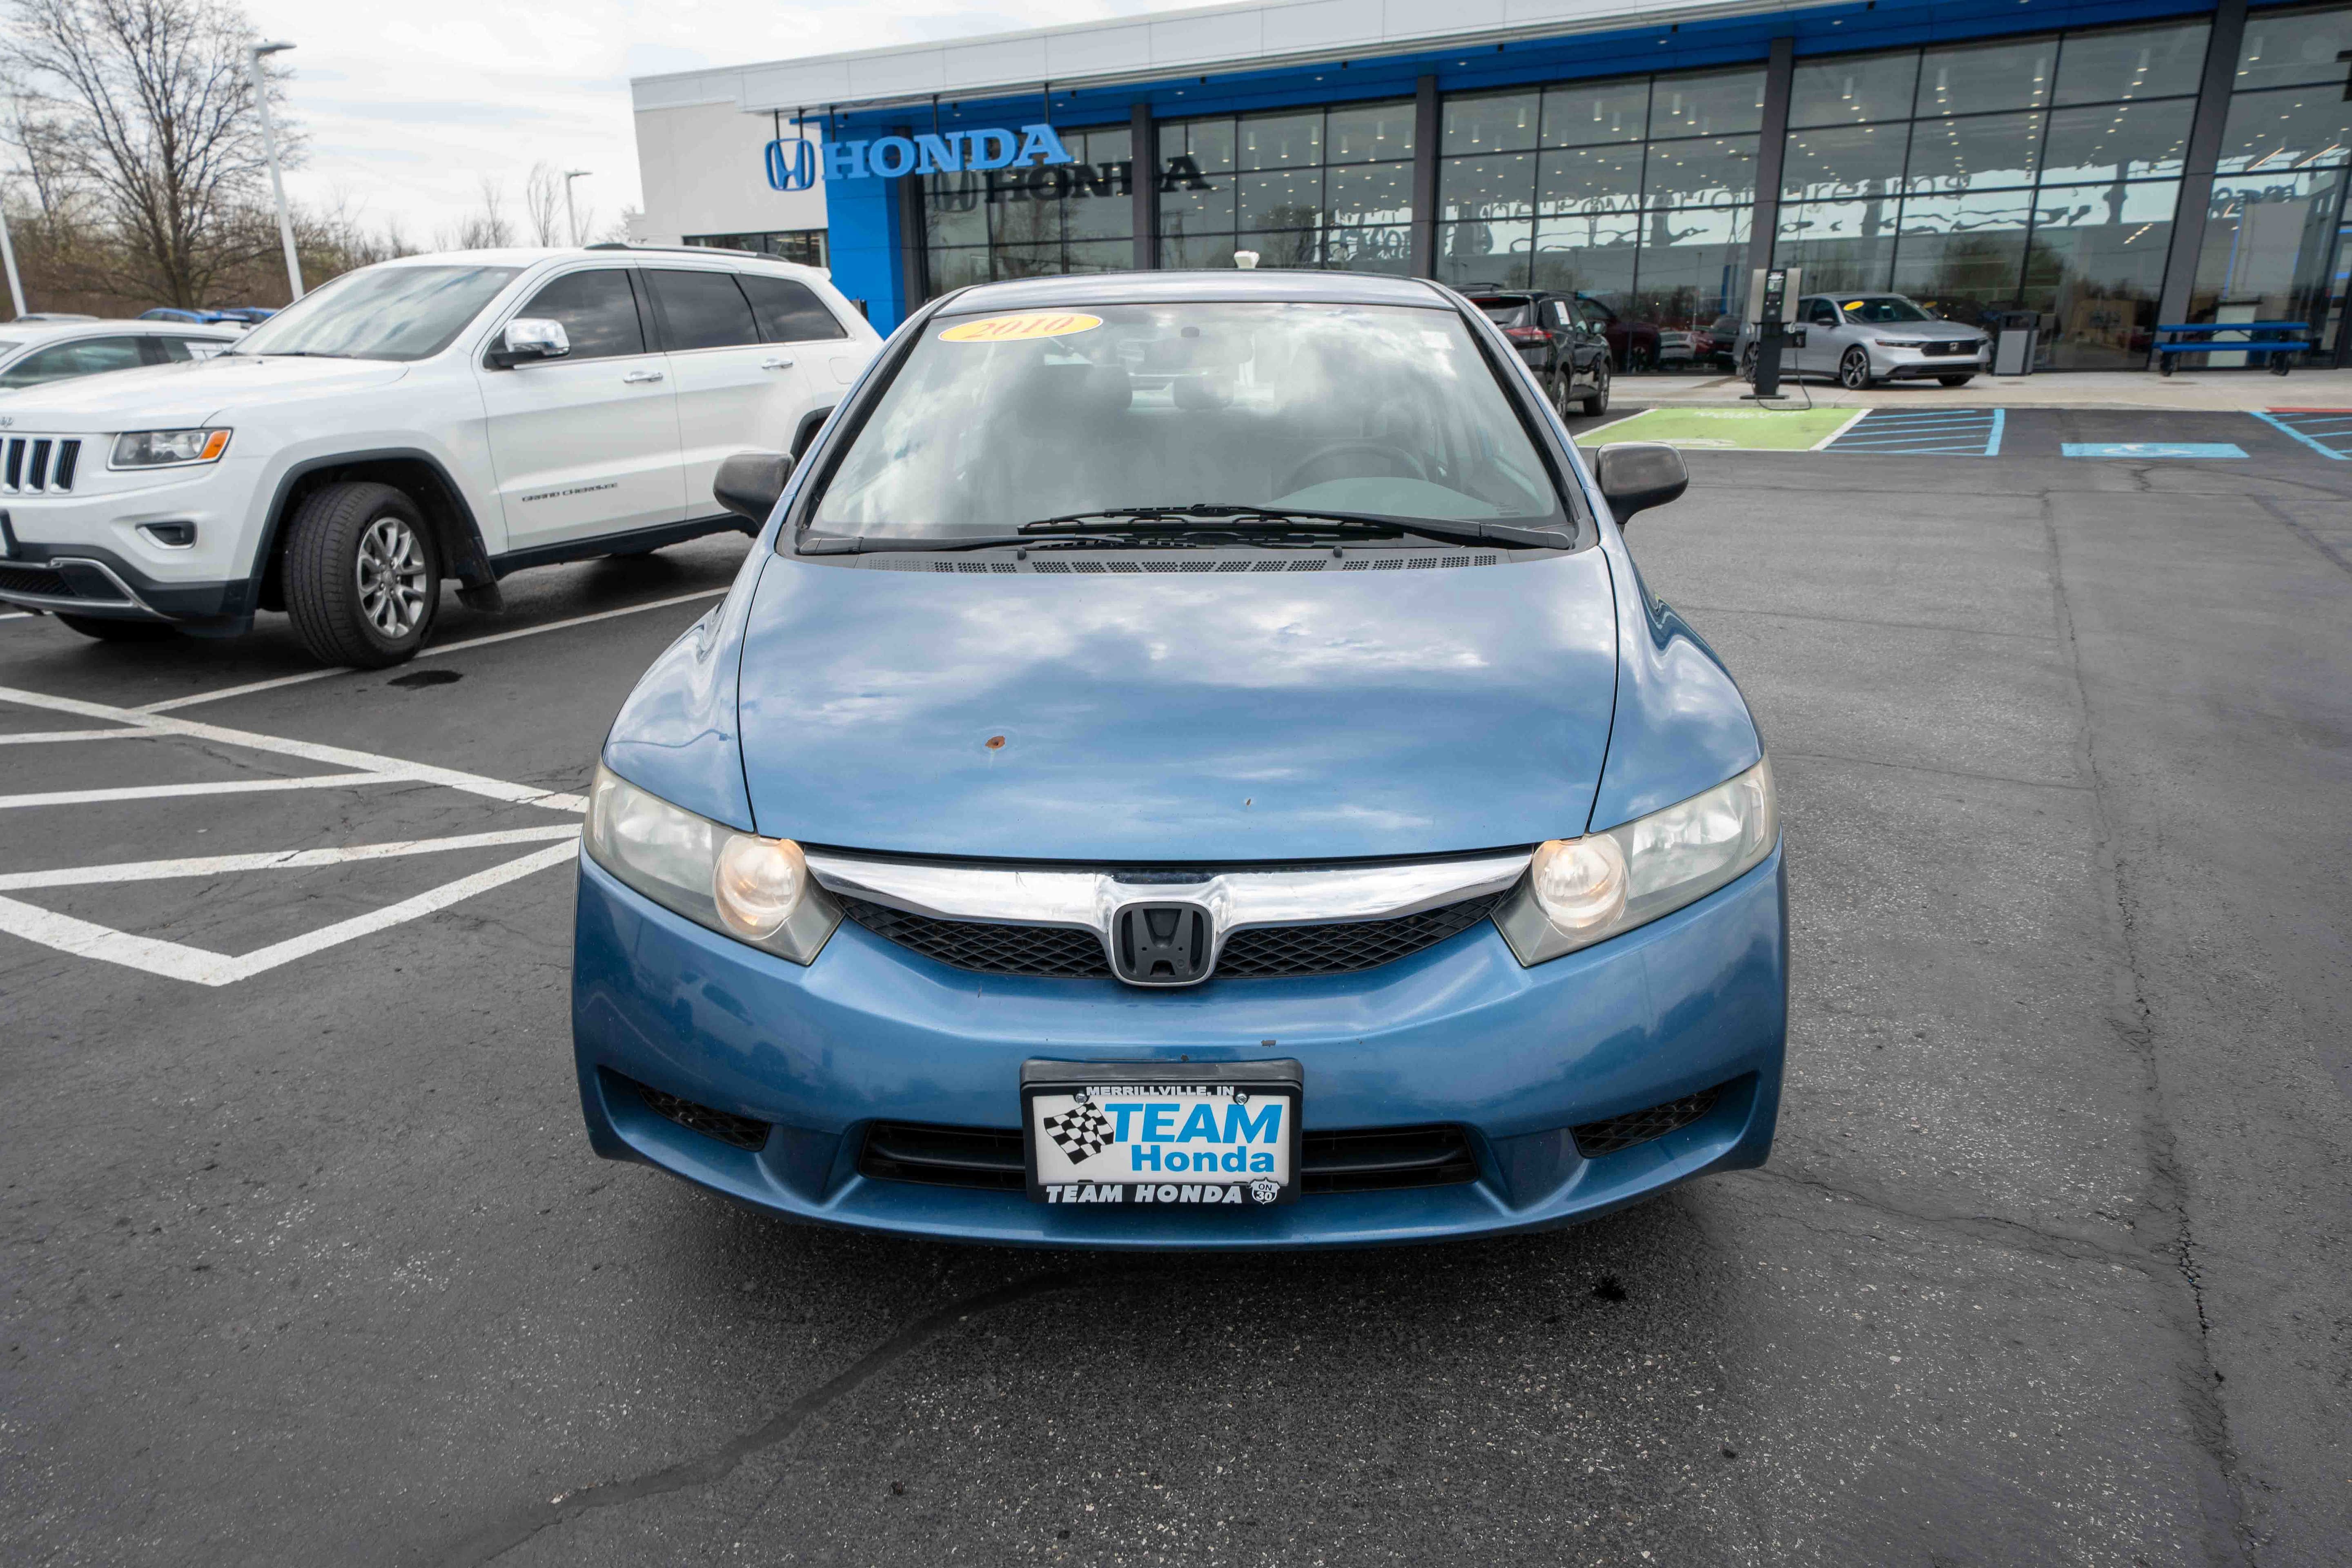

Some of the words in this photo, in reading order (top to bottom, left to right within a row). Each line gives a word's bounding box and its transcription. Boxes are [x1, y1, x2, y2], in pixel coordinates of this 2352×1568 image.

[821, 123, 1075, 180] HONDA
[982, 155, 1213, 203] HONA
[964, 316, 1075, 339] 2010
[1086, 1086, 1212, 1096] MERRILLVILLE,
[1217, 1086, 1234, 1096] IN
[1105, 1104, 1283, 1143] TEAM
[1131, 1145, 1274, 1172] Honda
[1046, 1185, 1123, 1203] TEAM
[1135, 1185, 1242, 1204] HONDA
[1256, 1191, 1272, 1201] 30
